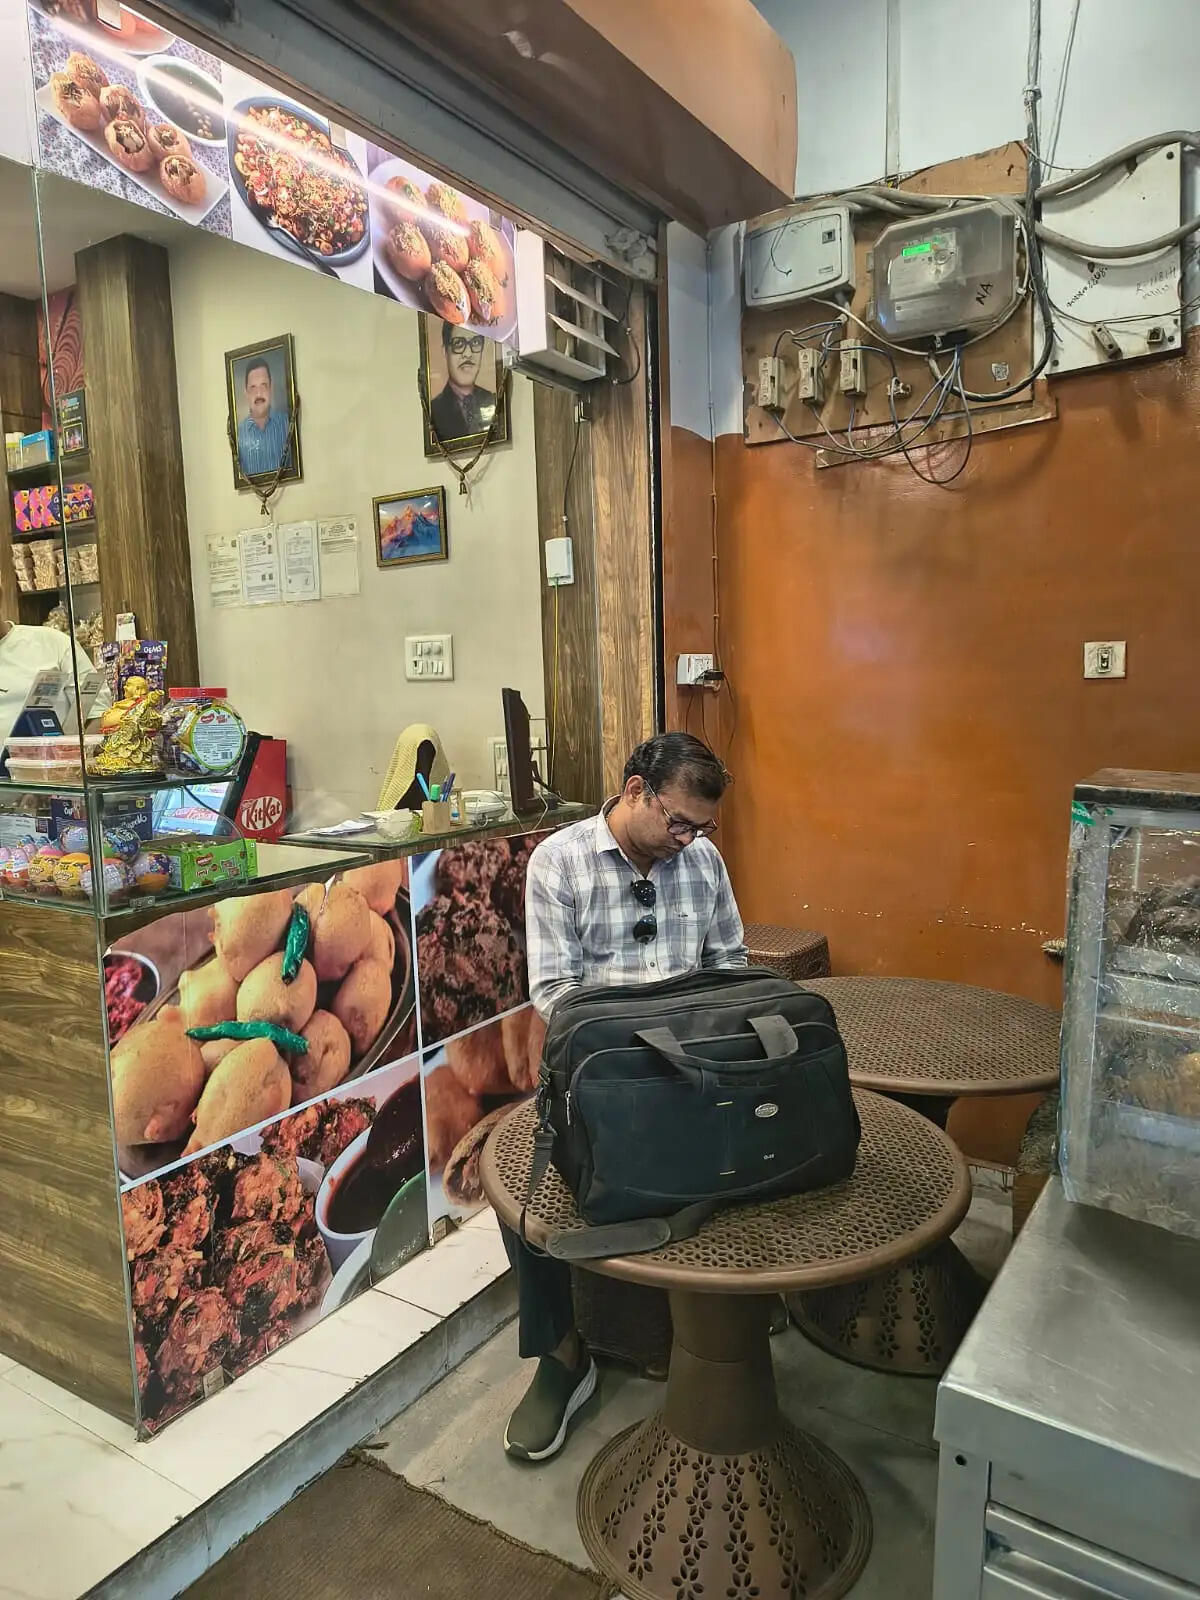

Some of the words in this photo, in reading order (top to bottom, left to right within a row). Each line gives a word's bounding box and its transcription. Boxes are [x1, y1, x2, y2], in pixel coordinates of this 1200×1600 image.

[975, 282, 994, 306] NA
[143, 645, 163, 654] GEMS
[245, 797, 281, 830] KitKat
